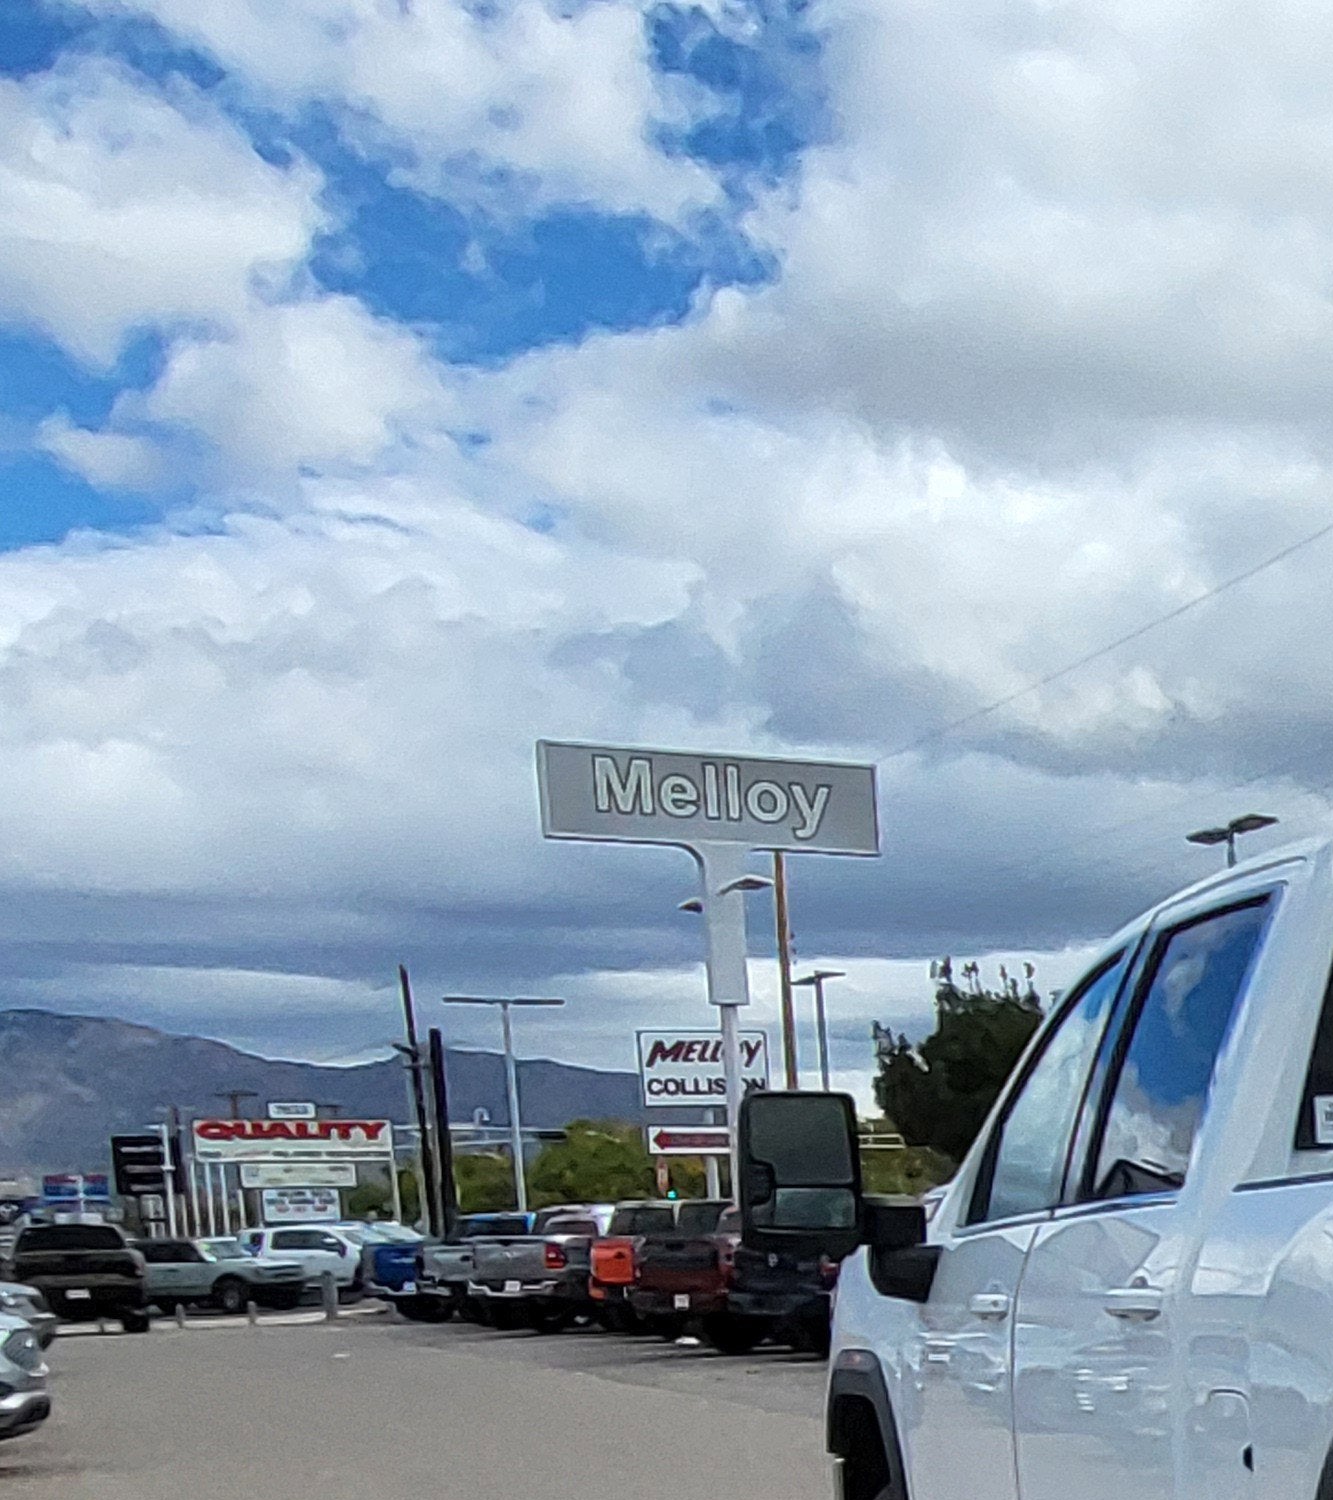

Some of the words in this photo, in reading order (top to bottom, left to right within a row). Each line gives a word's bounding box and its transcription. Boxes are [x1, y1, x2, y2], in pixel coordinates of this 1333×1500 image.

[592, 754, 832, 841] Melloy
[645, 1039, 762, 1068] MELLY
[647, 1076, 766, 1096] COLLISN
[197, 1121, 386, 1141] QUALITY
